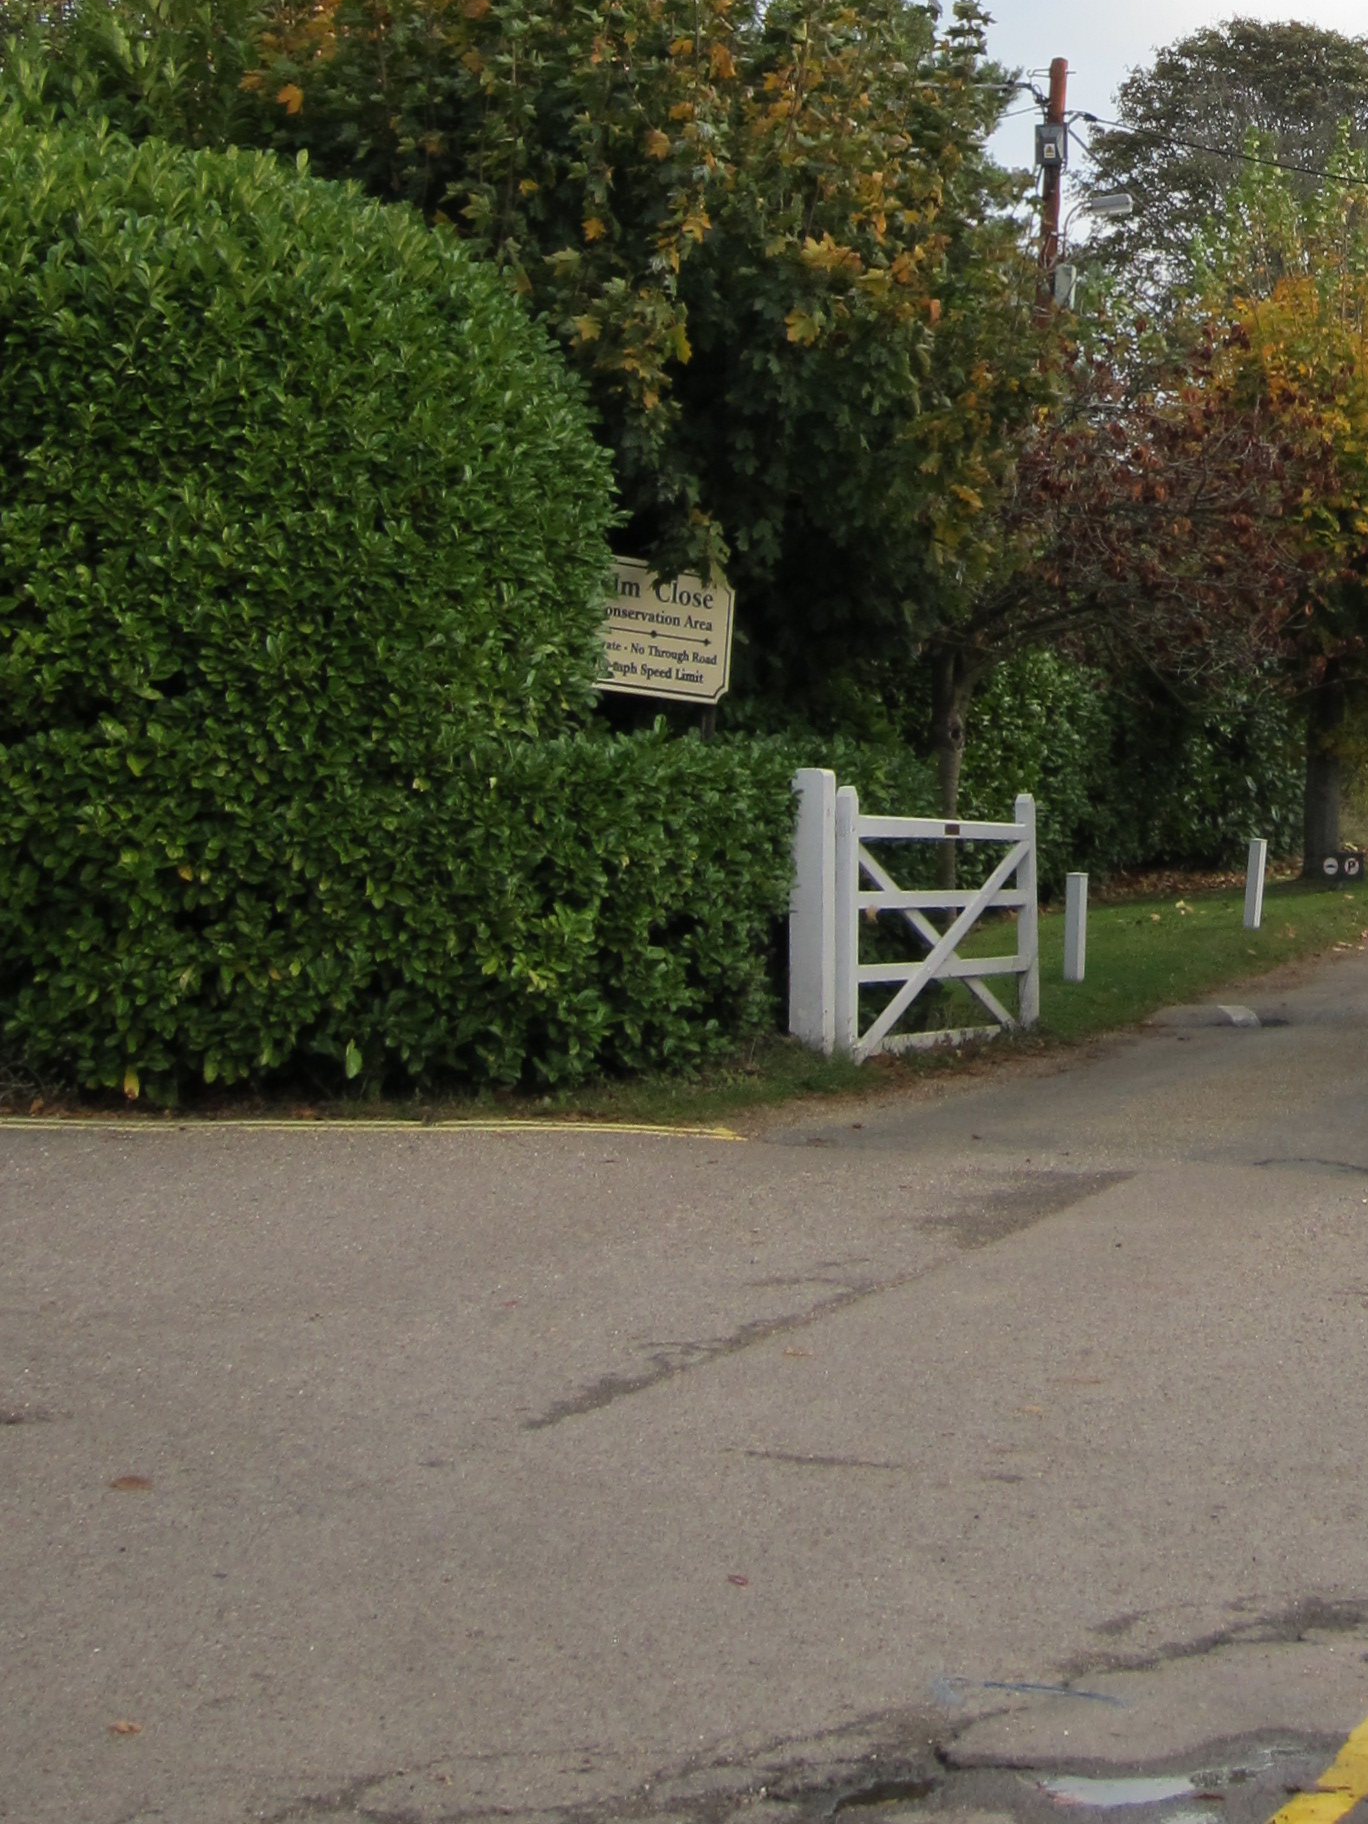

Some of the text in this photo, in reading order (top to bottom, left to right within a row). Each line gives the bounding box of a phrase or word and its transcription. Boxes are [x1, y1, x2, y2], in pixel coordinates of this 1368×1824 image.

[613, 573, 714, 609] lm Close
[605, 606, 713, 632] onservation Area
[602, 640, 621, 651] vate
[631, 642, 645, 655] No
[648, 645, 690, 664] Through
[692, 650, 717, 665] Road
[641, 663, 672, 679] Speed
[675, 668, 704, 684] Limit
